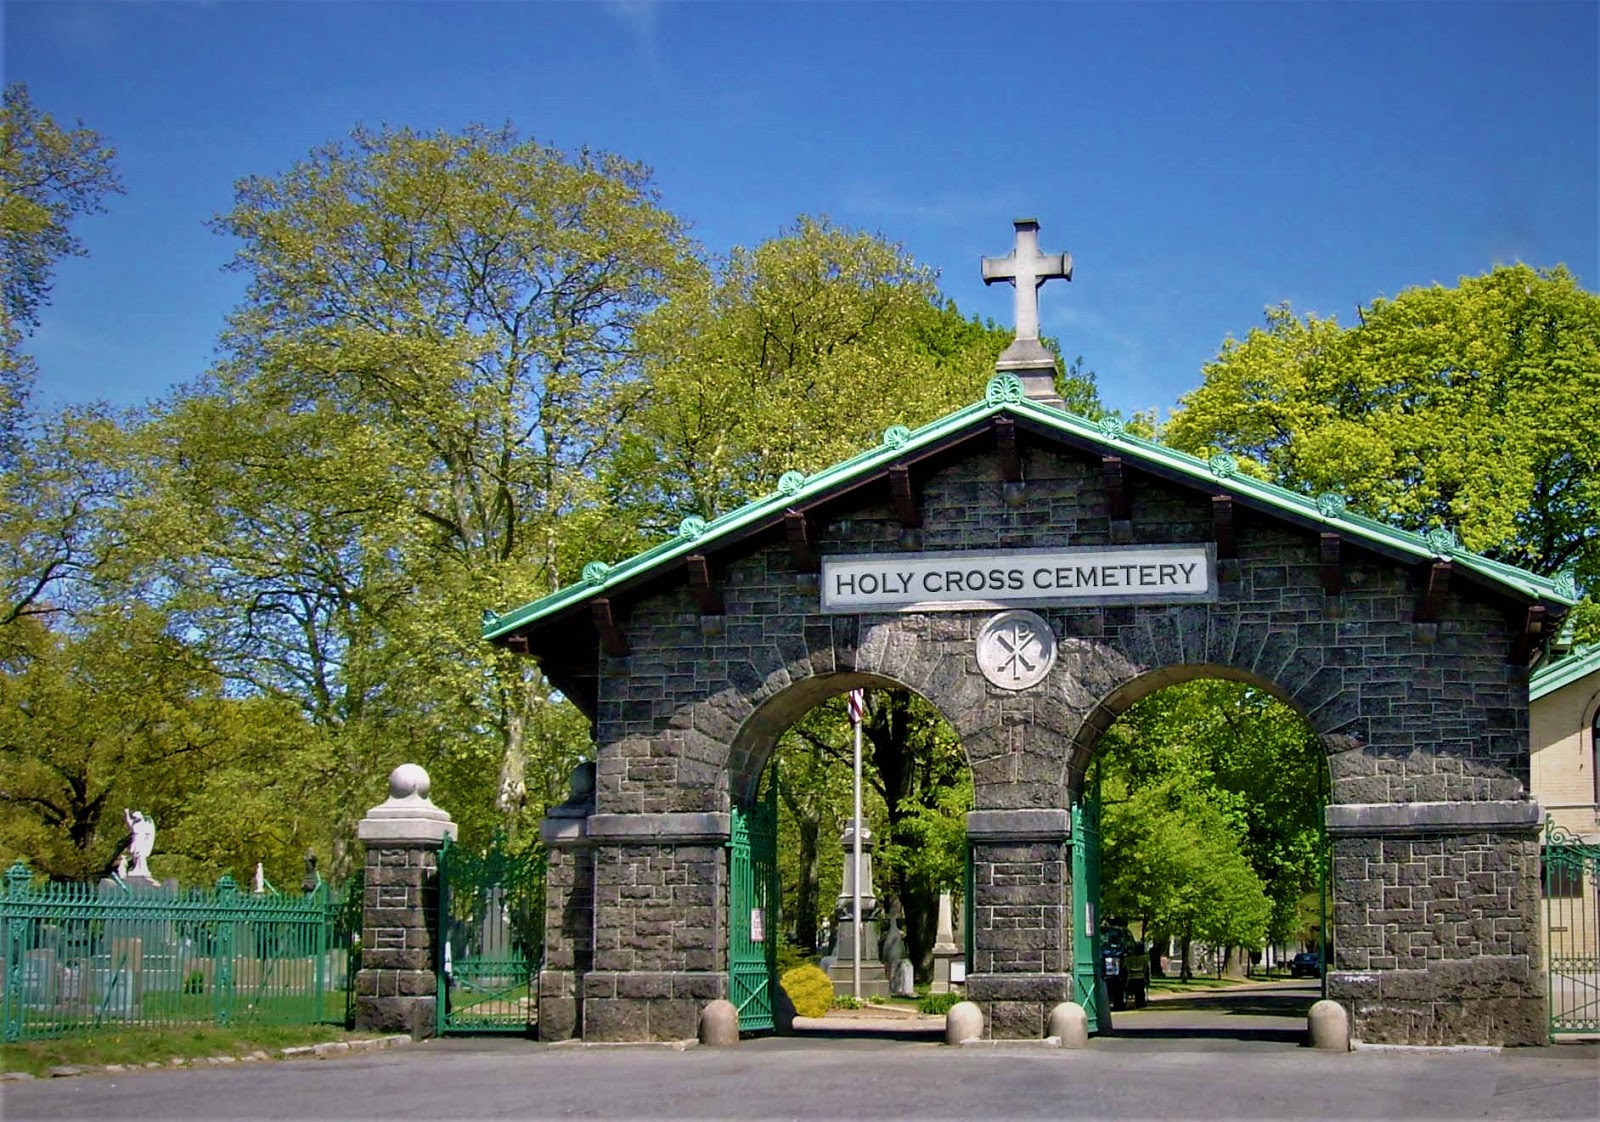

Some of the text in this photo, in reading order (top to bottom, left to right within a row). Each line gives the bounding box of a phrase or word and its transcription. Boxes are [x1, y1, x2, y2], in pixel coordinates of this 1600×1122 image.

[836, 563, 1197, 595] HOLY CROSS CEMETERY
